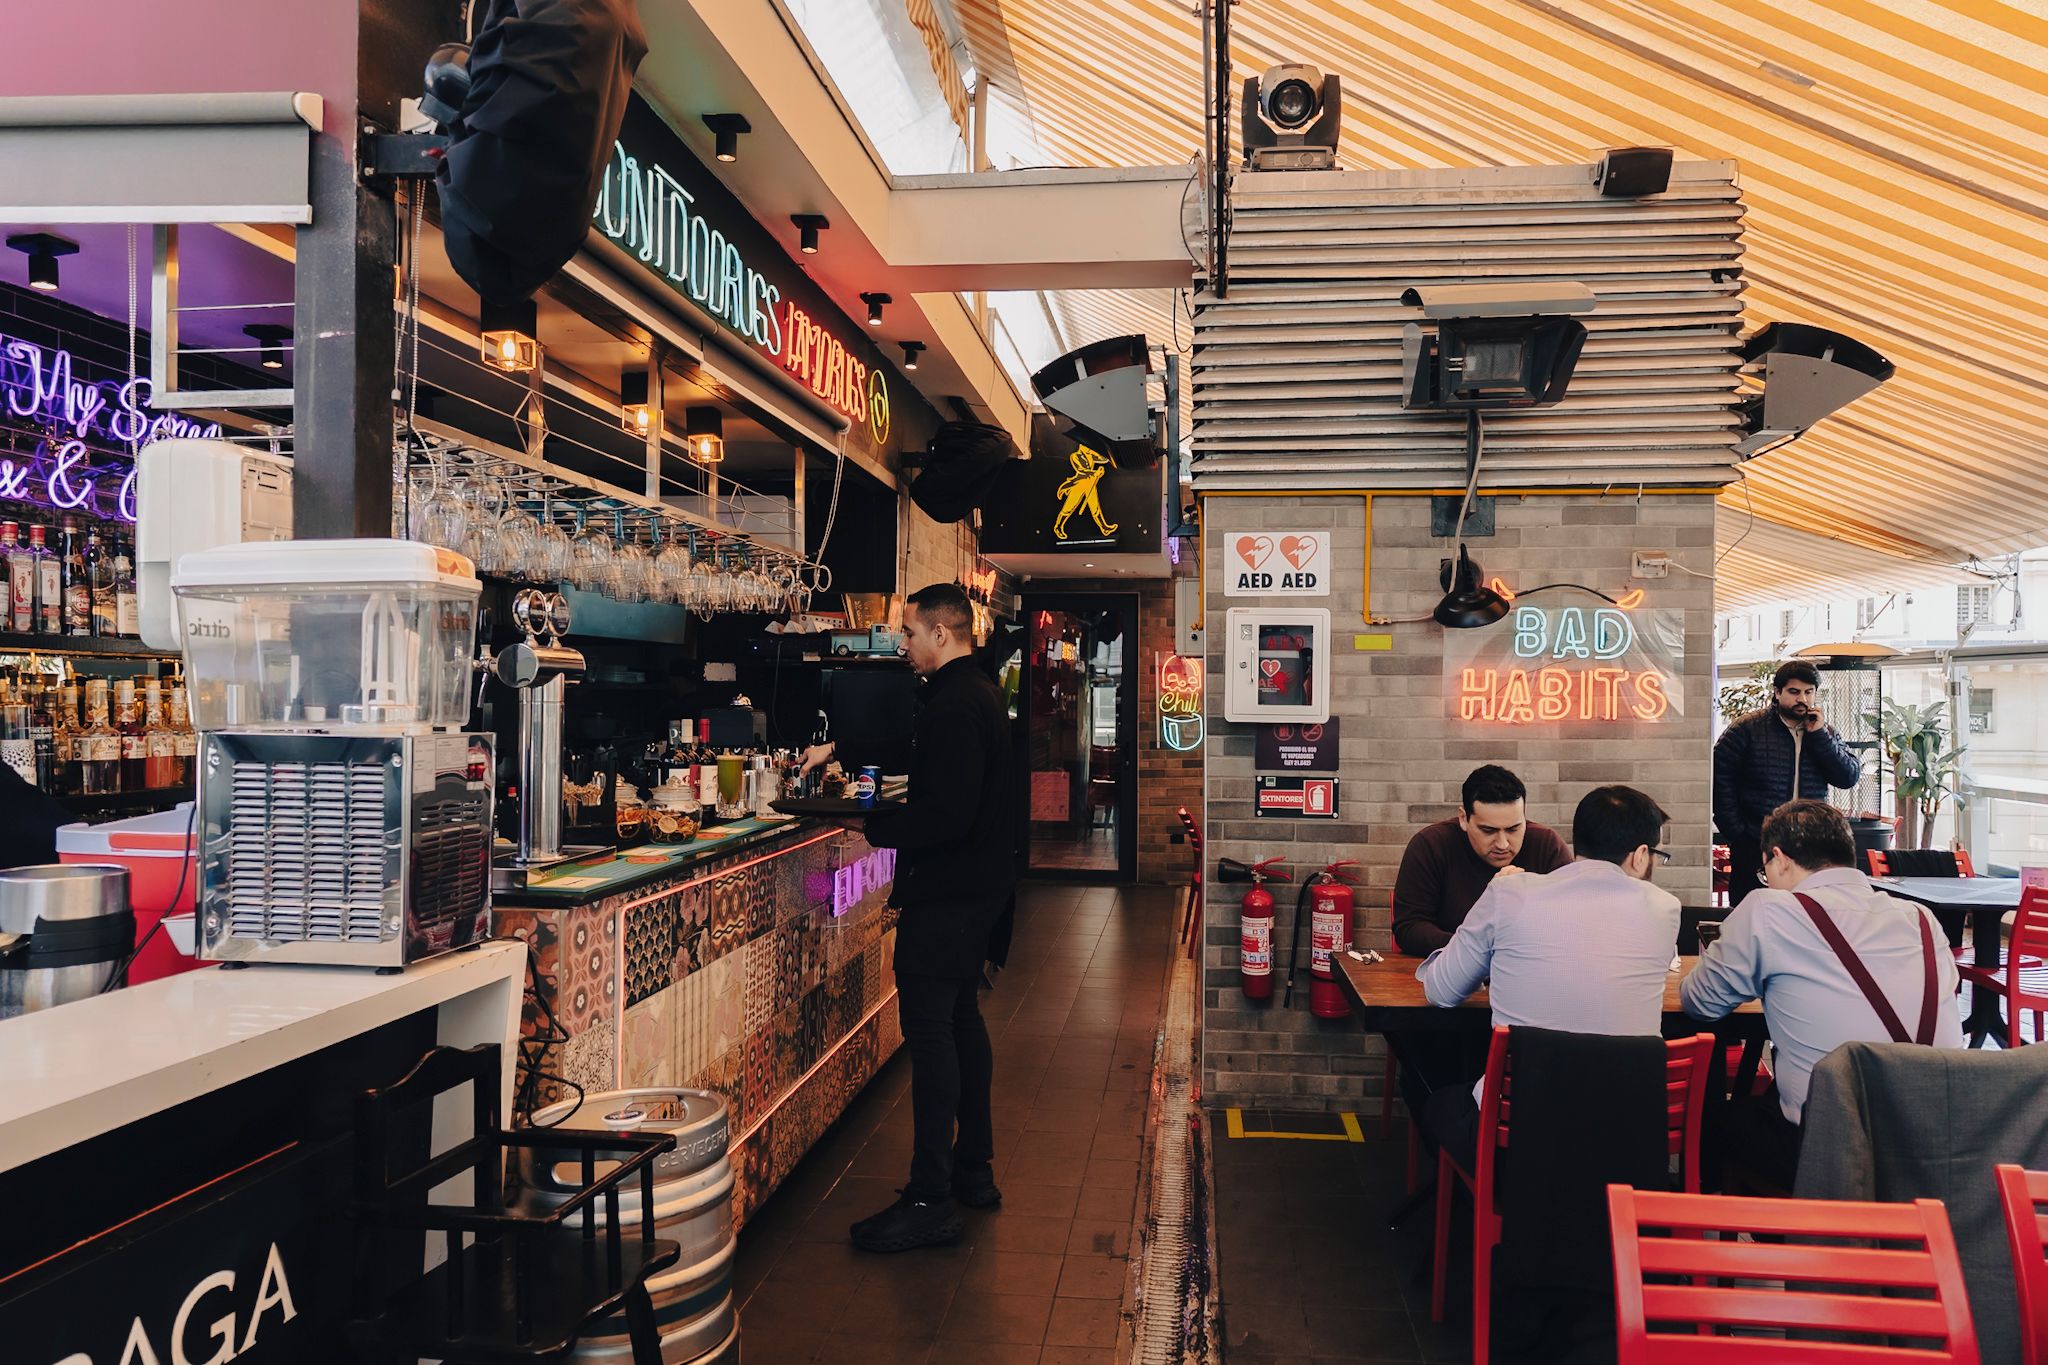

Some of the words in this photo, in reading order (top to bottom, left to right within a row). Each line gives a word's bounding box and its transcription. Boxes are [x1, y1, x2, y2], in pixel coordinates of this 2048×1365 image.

[1238, 573, 1273, 588] AED
[1281, 573, 1317, 588] AED
[1514, 606, 1634, 660] BAD
[1258, 678, 1277, 688] AE
[1159, 692, 1201, 713] Chill
[1460, 667, 1668, 721] HABITS
[1260, 795, 1303, 803] EXTINTORES
